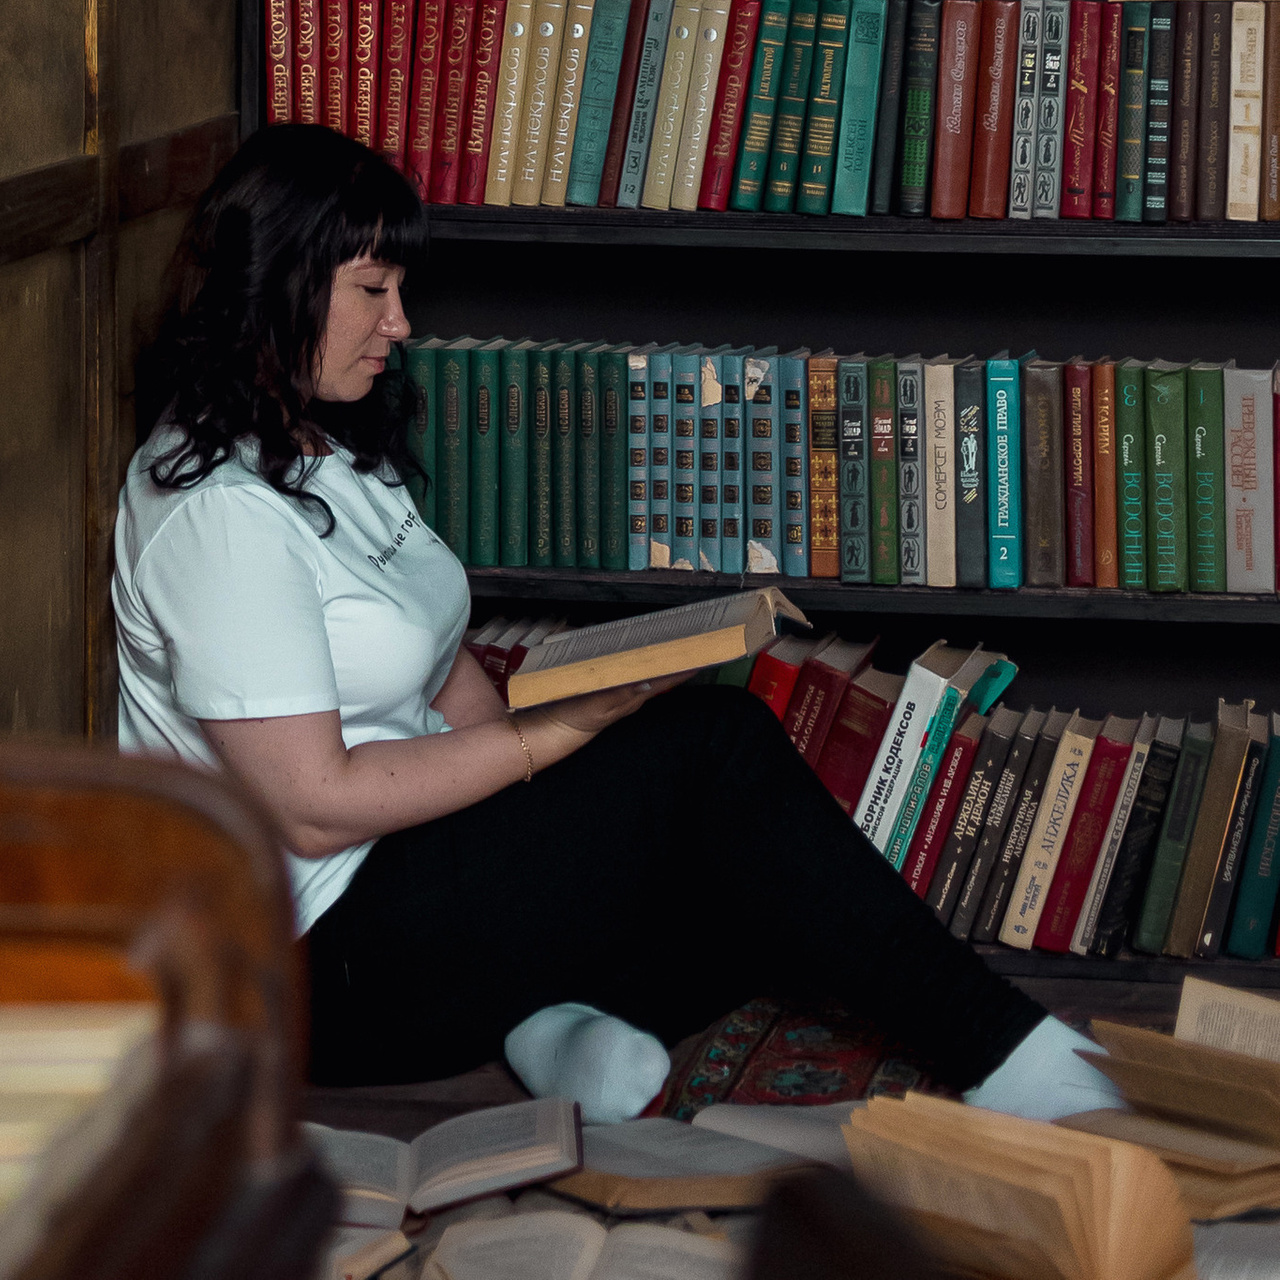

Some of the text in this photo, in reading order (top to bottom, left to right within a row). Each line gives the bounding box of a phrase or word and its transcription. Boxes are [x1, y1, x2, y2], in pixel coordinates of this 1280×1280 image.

[269, 0, 289, 123] ЛЬТЕР СКОТТ
[383, 1, 406, 153] ВАЛЬТЕР СКОТТ
[636, 41, 654, 104] КАМЕННЫЙ
[843, 118, 858, 172] АЛЕКСЕЙ
[853, 119, 867, 172] ТОЛСТОЙ
[933, 399, 948, 510] СОМЕРСЕТ МОЭМ
[1072, 438, 1084, 486] КОРОТИЧ
[1230, 428, 1243, 488] РАССВЕТ
[1240, 395, 1258, 491] ТРЕВОЖНЫЙ
[996, 389, 1010, 560] 2 ГРАЖДАНСКОЕ ПРАВО
[1121, 384, 1144, 585] 3 Сергей ВОРОНИН
[393, 533, 406, 547] не
[882, 700, 917, 779] КОДЕКСОВ
[883, 758, 904, 805] ФЕДЕРАЦИИ
[900, 761, 932, 836] АДМИРАЛОВ
[953, 769, 985, 840] АНЖЕЛИКА
[966, 780, 993, 838] И ДЕМОН
[993, 773, 1016, 827] АНЖЕЛИКИ
[1124, 760, 1142, 807] ПОЛКА
[925, 794, 949, 846] АНЖЕЛИКА
[1002, 788, 1034, 864] НЕУКРОТИМАЯ
[1222, 823, 1245, 883] ИСЧЕЗНУВШИЙ
